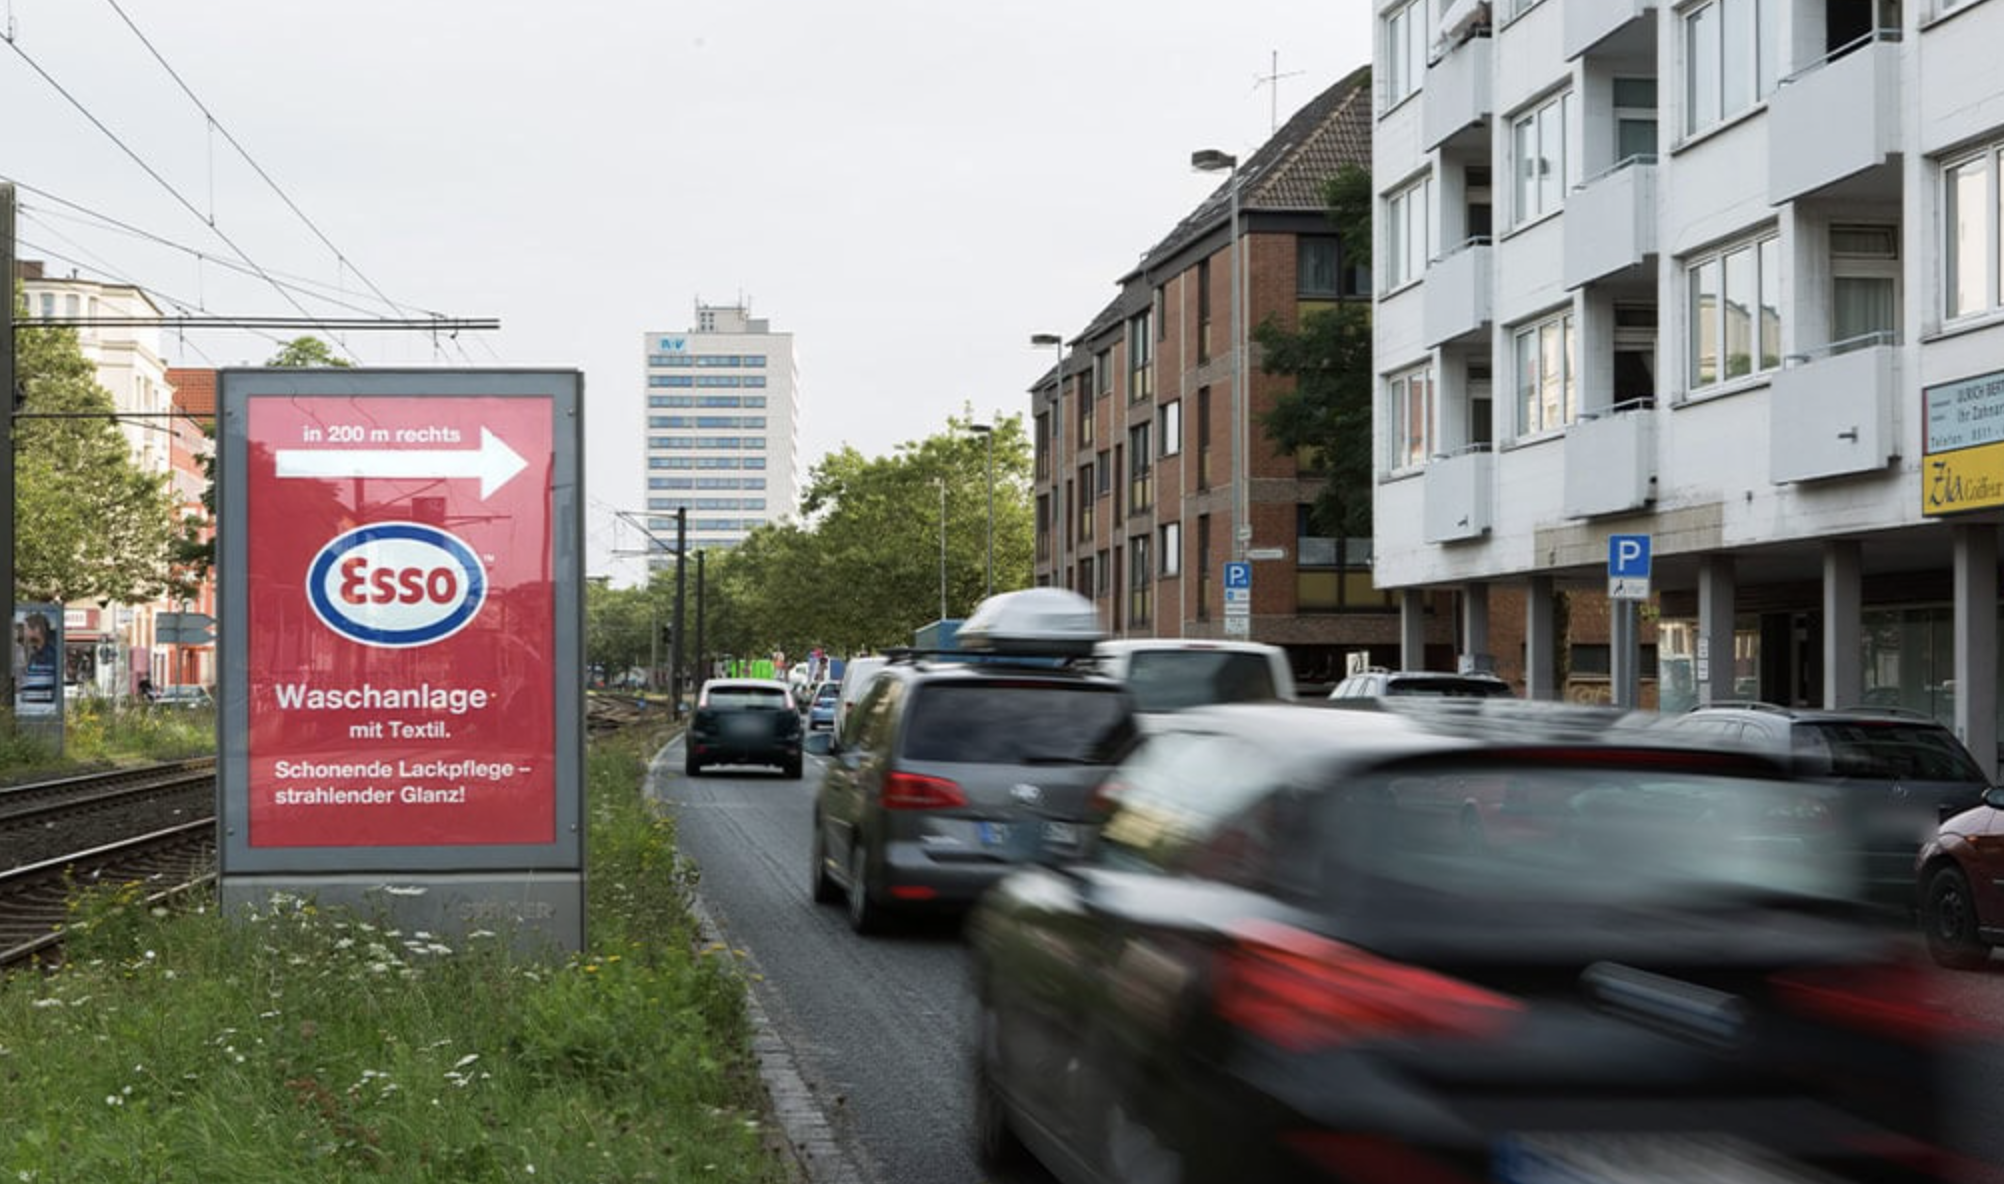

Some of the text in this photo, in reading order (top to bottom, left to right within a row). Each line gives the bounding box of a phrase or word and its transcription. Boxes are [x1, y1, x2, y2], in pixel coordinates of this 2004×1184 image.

[303, 425, 461, 442] in 200 m rechts
[1617, 540, 1641, 571] P
[339, 557, 457, 604] Esso
[275, 683, 488, 714] Waschanlage
[350, 721, 451, 738] mit Textil.
[275, 761, 393, 779] Schonende
[399, 760, 514, 781] Lackpflege
[275, 786, 466, 804] strahlender Glanz!
